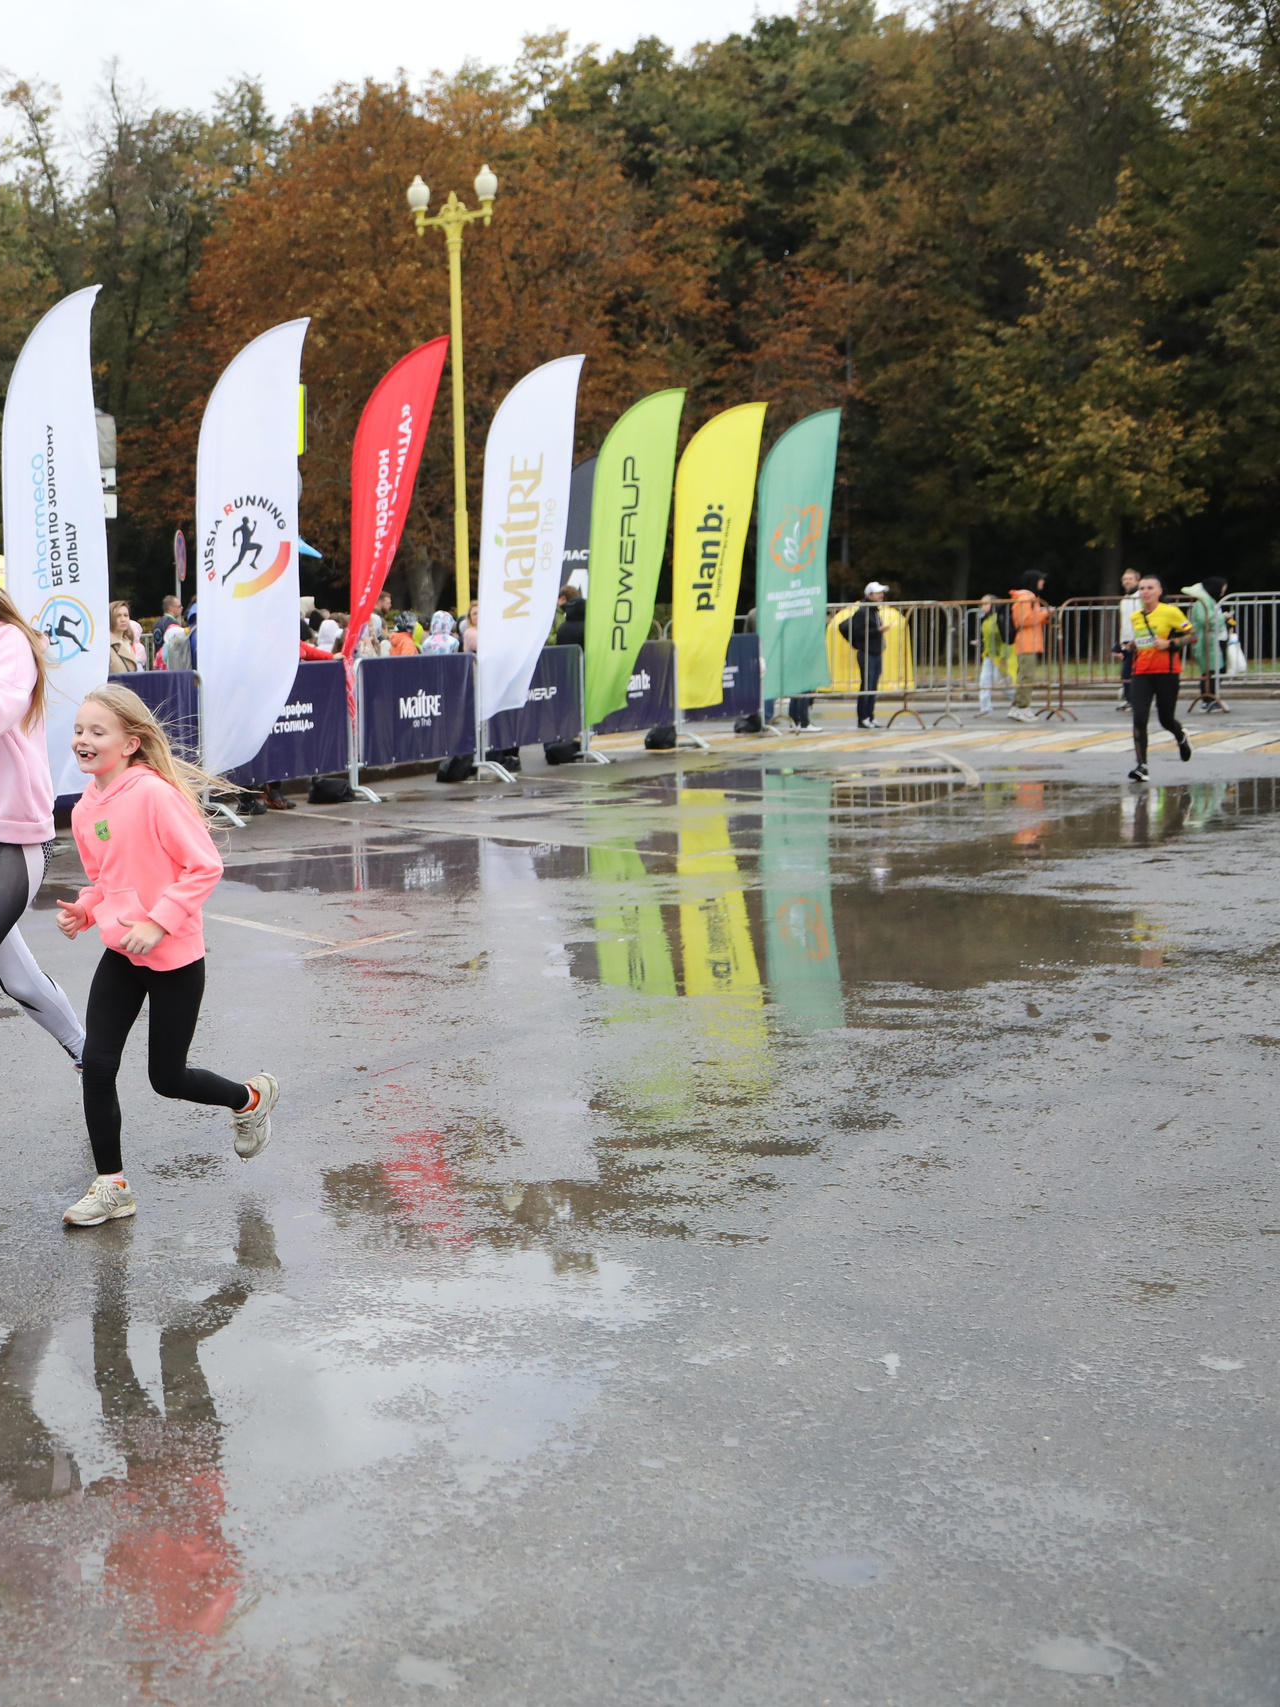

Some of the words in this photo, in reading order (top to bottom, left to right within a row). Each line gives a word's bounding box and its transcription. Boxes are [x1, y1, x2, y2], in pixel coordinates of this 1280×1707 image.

[46, 424, 58, 507] ЗОЛОТОМУ
[31, 453, 51, 590] pharmeco
[48, 512, 59, 535] ПО
[65, 521, 80, 584] КОЛЬЦУ
[204, 519, 223, 582] RUSSIA
[223, 495, 287, 530] RUNNING
[612, 456, 640, 650] POWERUP
[50, 537, 63, 587] БЕГОМ
[692, 540, 721, 611] plan
[280, 701, 313, 719] арафон
